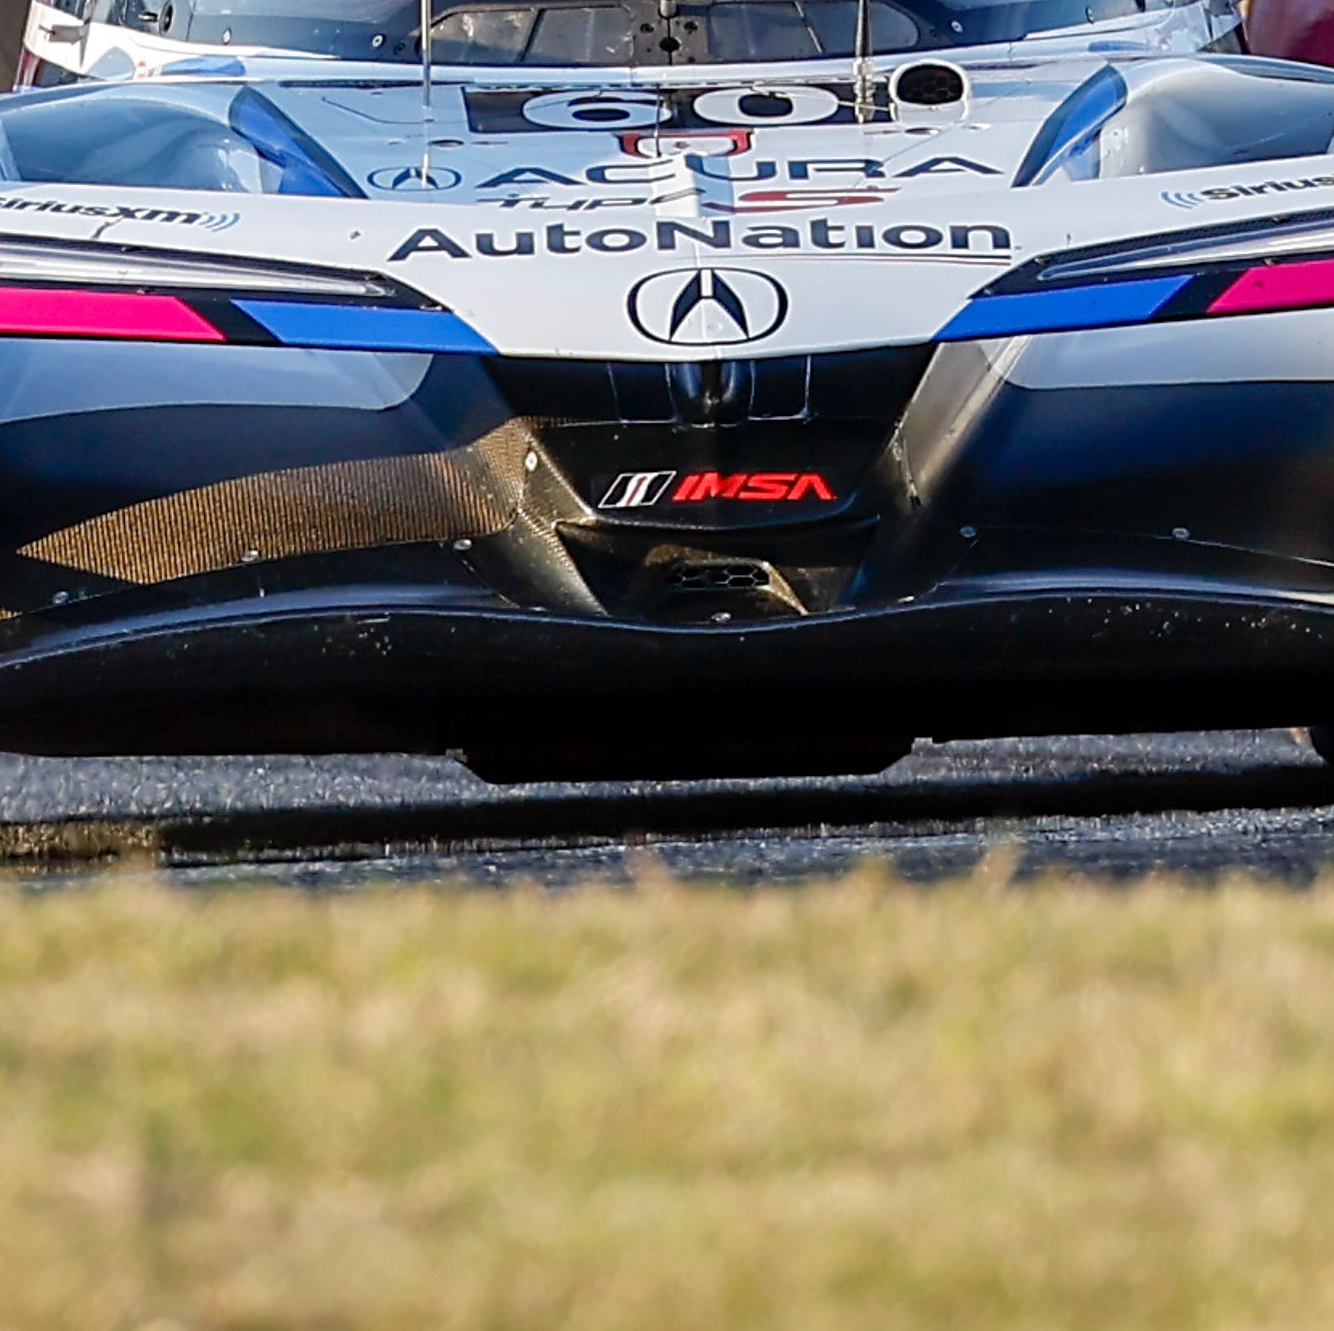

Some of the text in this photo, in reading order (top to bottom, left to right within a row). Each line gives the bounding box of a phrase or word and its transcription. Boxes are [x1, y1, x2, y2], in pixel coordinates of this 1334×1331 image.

[522, 85, 840, 130] 60
[476, 153, 1007, 188] ACURA
[386, 217, 1014, 263] AutoNation
[671, 471, 838, 502] IMSA
